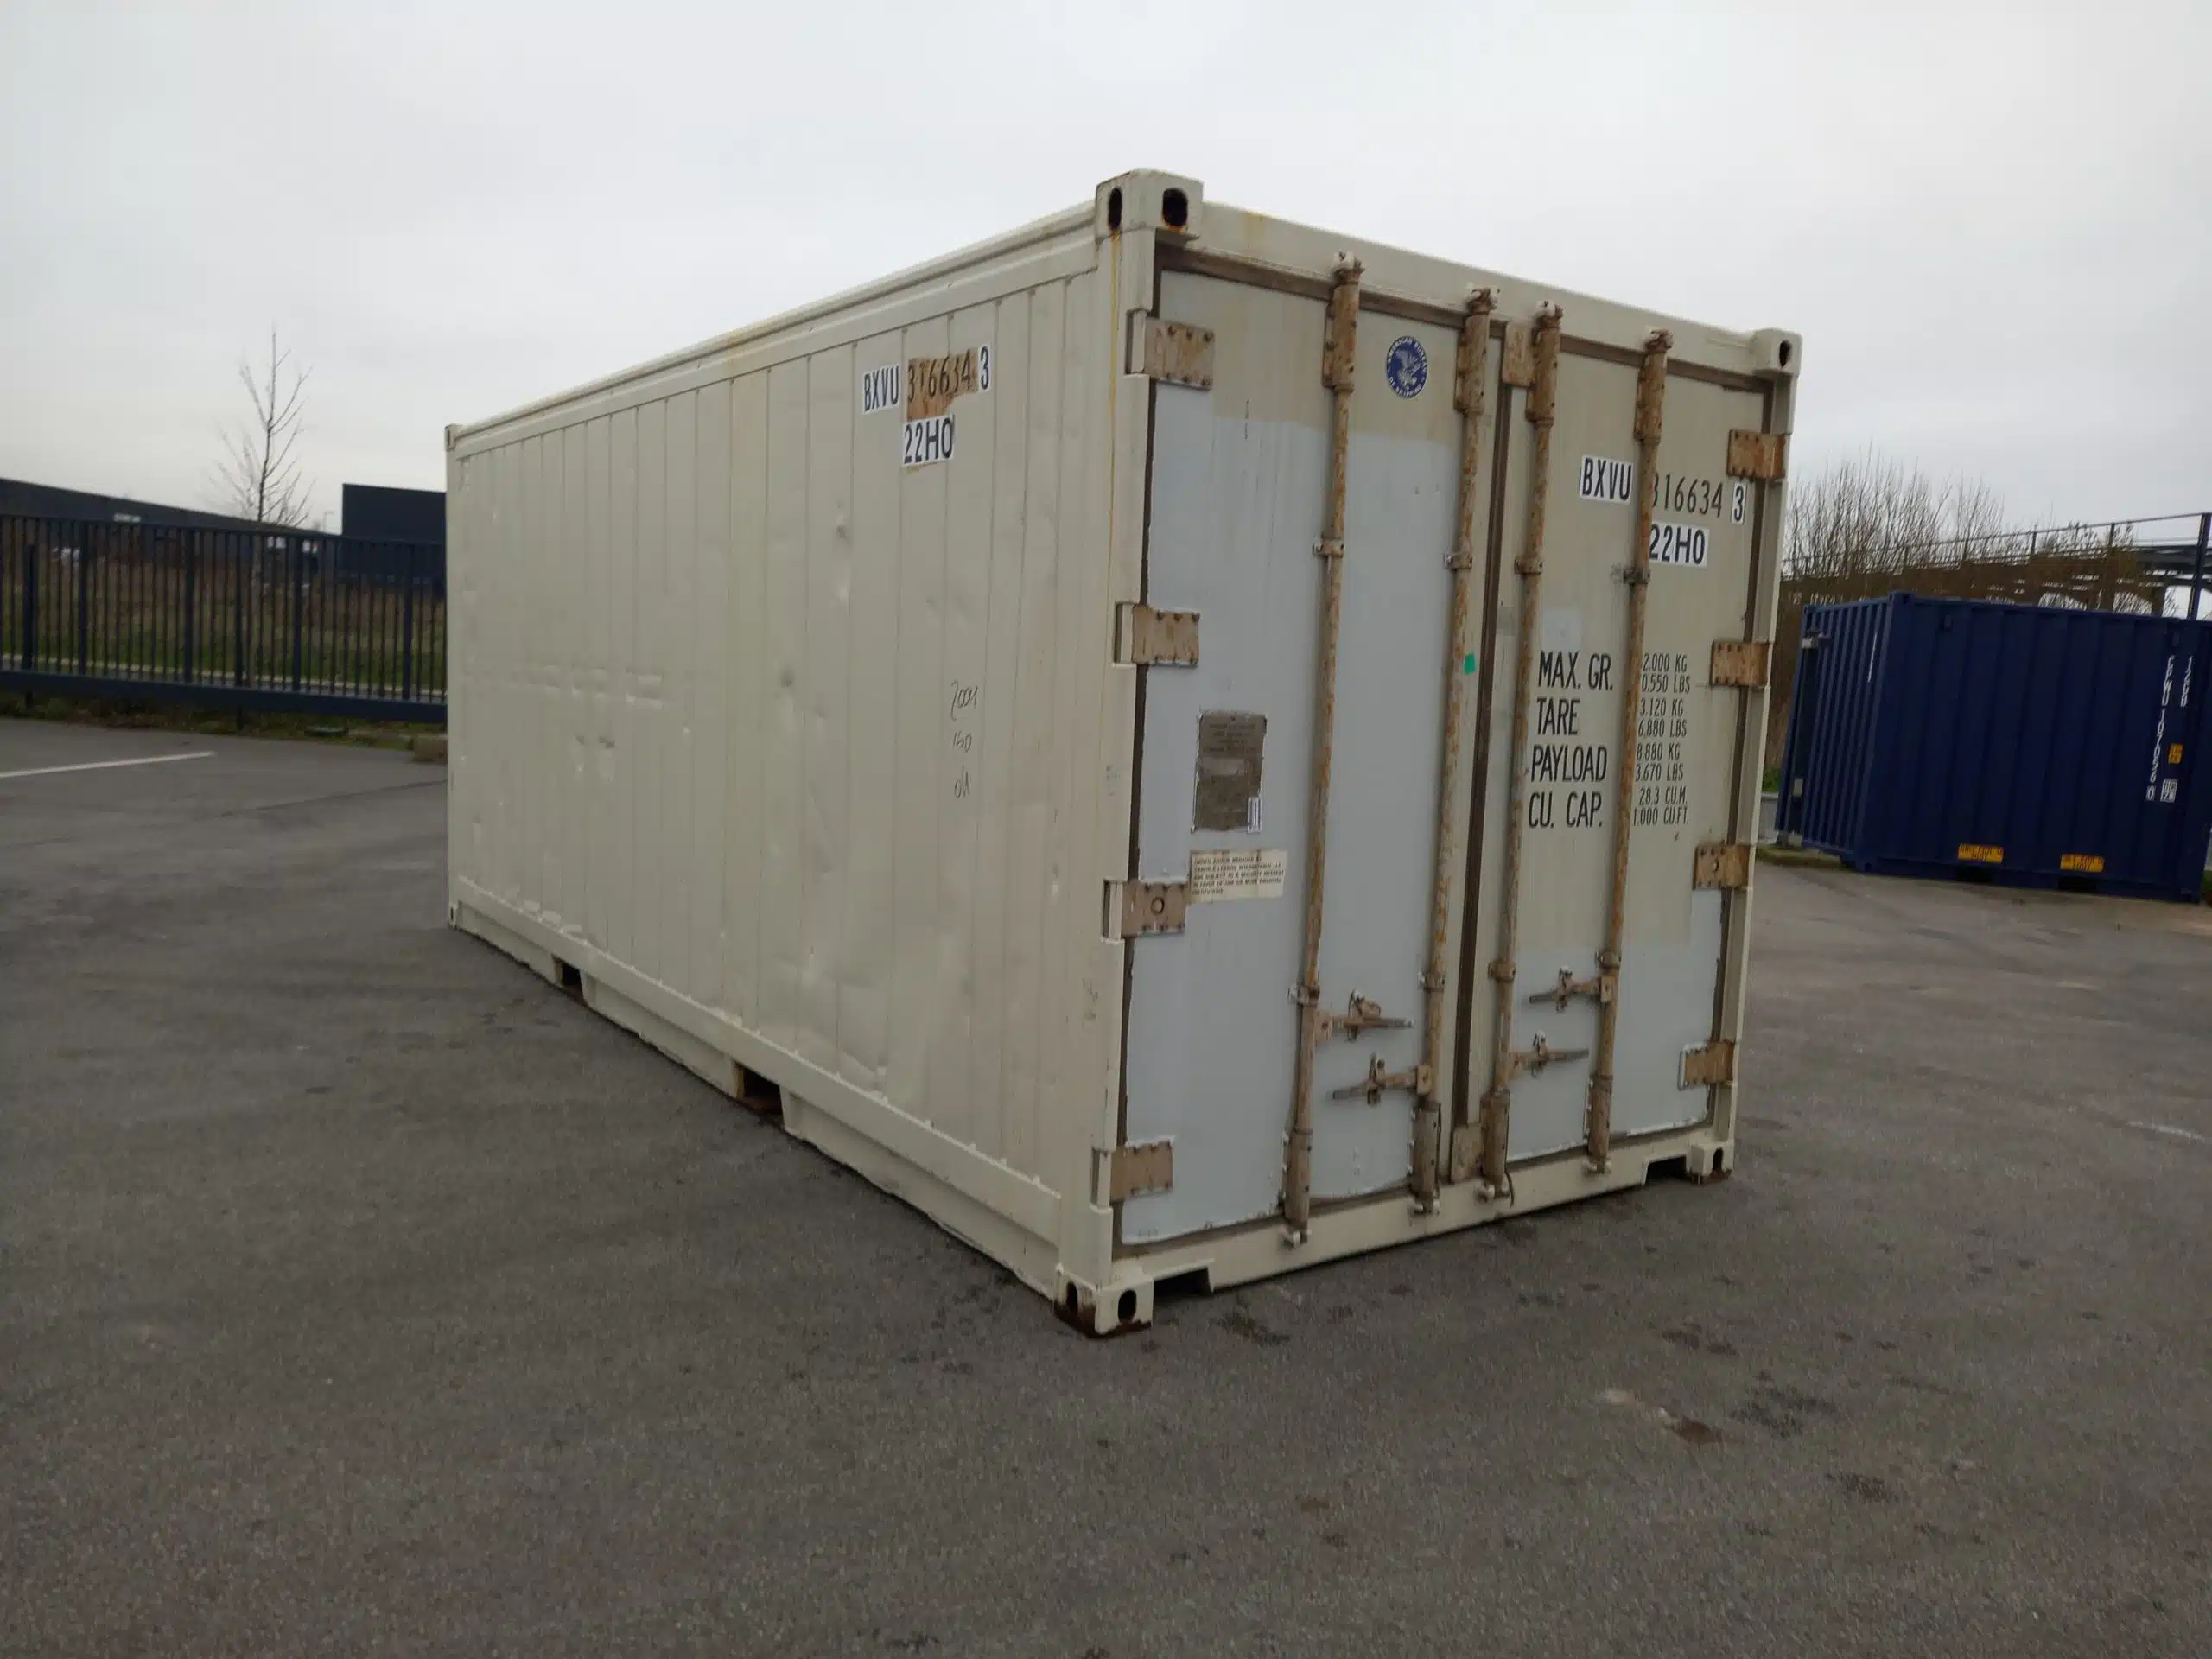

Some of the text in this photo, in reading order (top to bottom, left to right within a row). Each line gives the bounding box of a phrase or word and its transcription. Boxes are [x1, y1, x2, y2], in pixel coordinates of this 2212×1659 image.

[863, 345, 990, 412] BXVU 316634 3
[1581, 457, 1632, 501] BXVU
[1733, 486, 1745, 522] 3
[1538, 651, 1614, 690] MAX. GR.
[1675, 653, 1688, 673] KG
[1673, 674, 1690, 694] LBS
[1536, 697, 1580, 735] TARE
[1671, 698, 1684, 717] KG
[1669, 719, 1688, 738] LBS
[1530, 744, 1608, 783] PAYLOAD
[1668, 742, 1681, 761] KG
[1666, 762, 1684, 782] LBS
[1528, 791, 1603, 829] CU. CAP.
